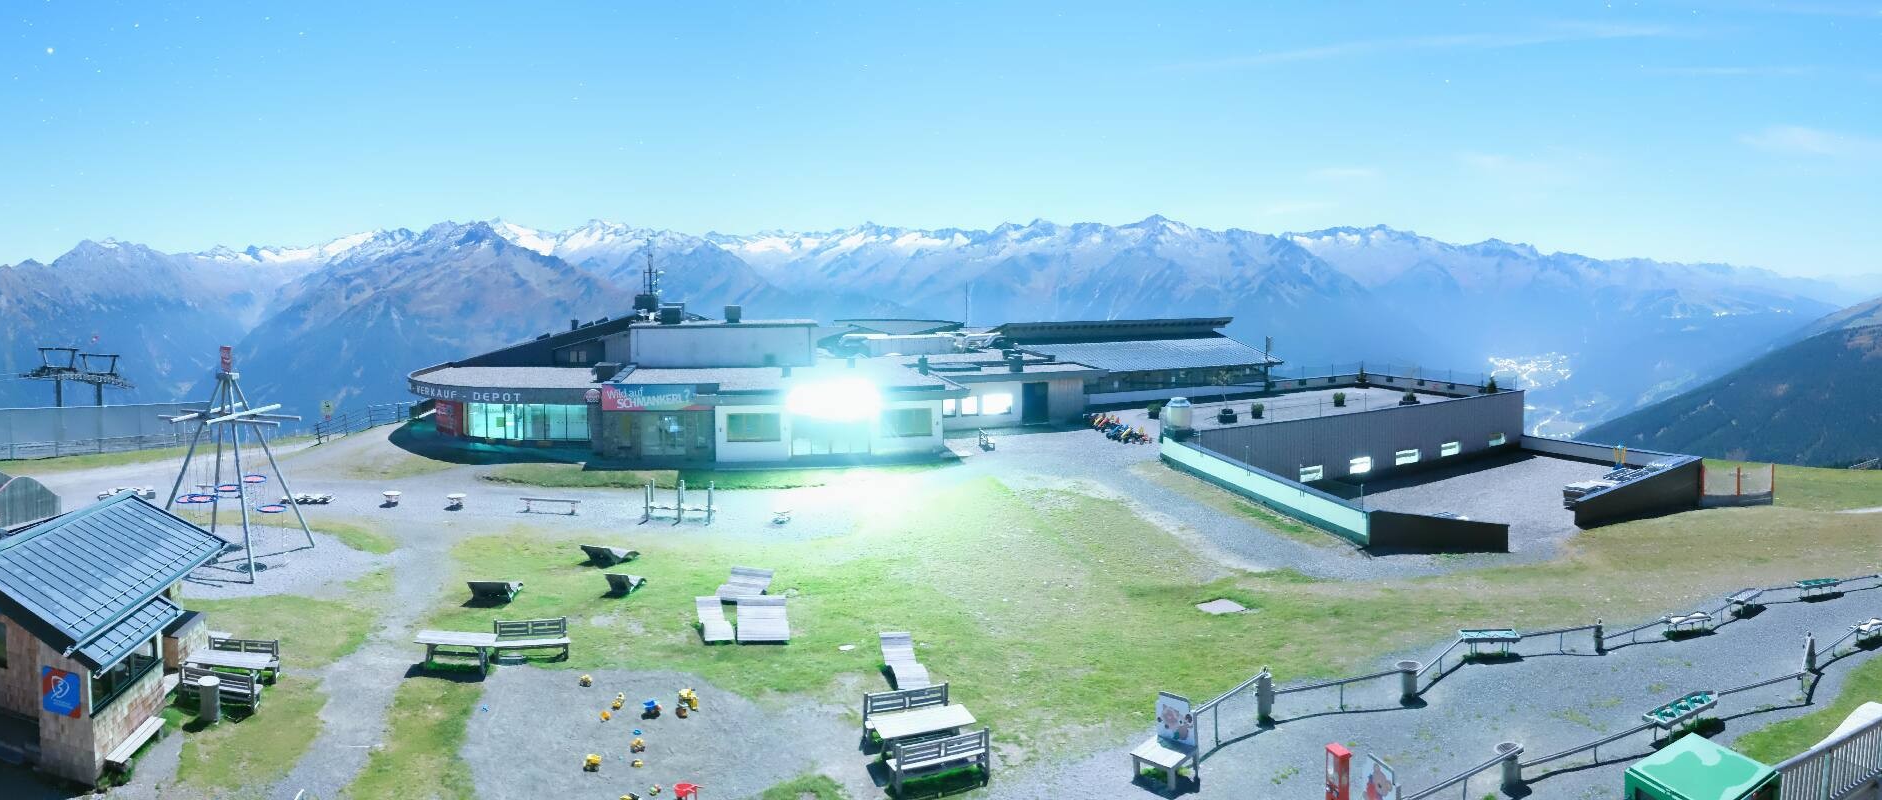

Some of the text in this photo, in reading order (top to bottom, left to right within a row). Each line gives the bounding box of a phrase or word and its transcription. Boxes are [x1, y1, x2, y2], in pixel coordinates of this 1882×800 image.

[417, 385, 521, 402] VERKAUF DEPOT
[606, 388, 627, 400] Wild
[629, 386, 644, 398] auf
